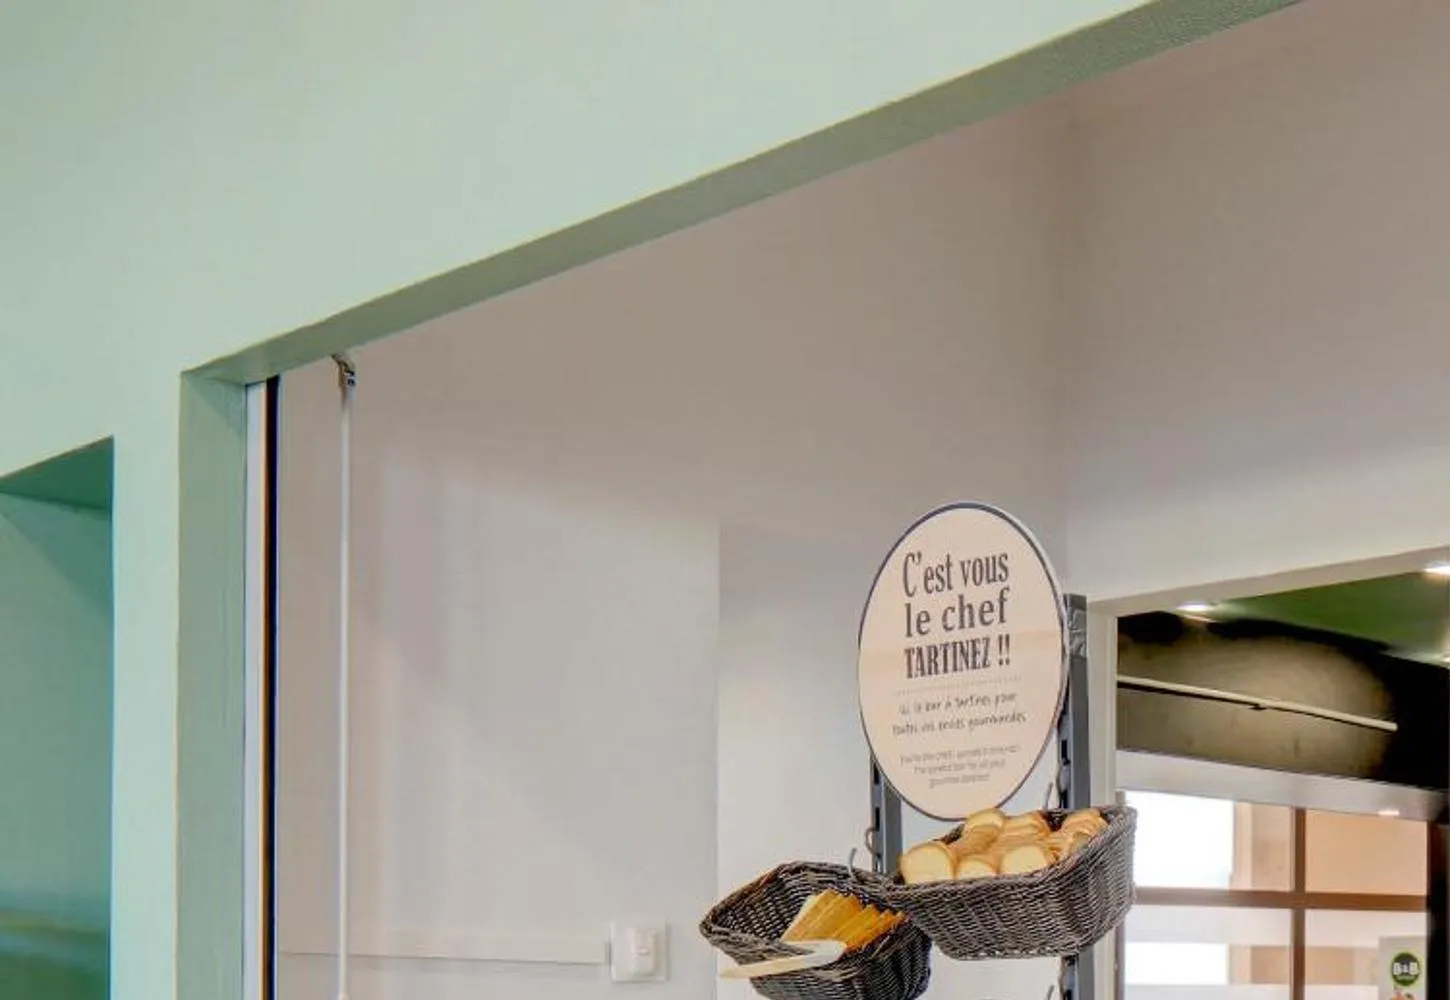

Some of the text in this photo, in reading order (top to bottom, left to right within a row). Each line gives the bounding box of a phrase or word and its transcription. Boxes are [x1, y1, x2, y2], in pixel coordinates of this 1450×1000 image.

[903, 551, 1009, 597] C'est vous
[905, 587, 1011, 638] le chef
[904, 633, 1011, 679] TARTINEZ !!
